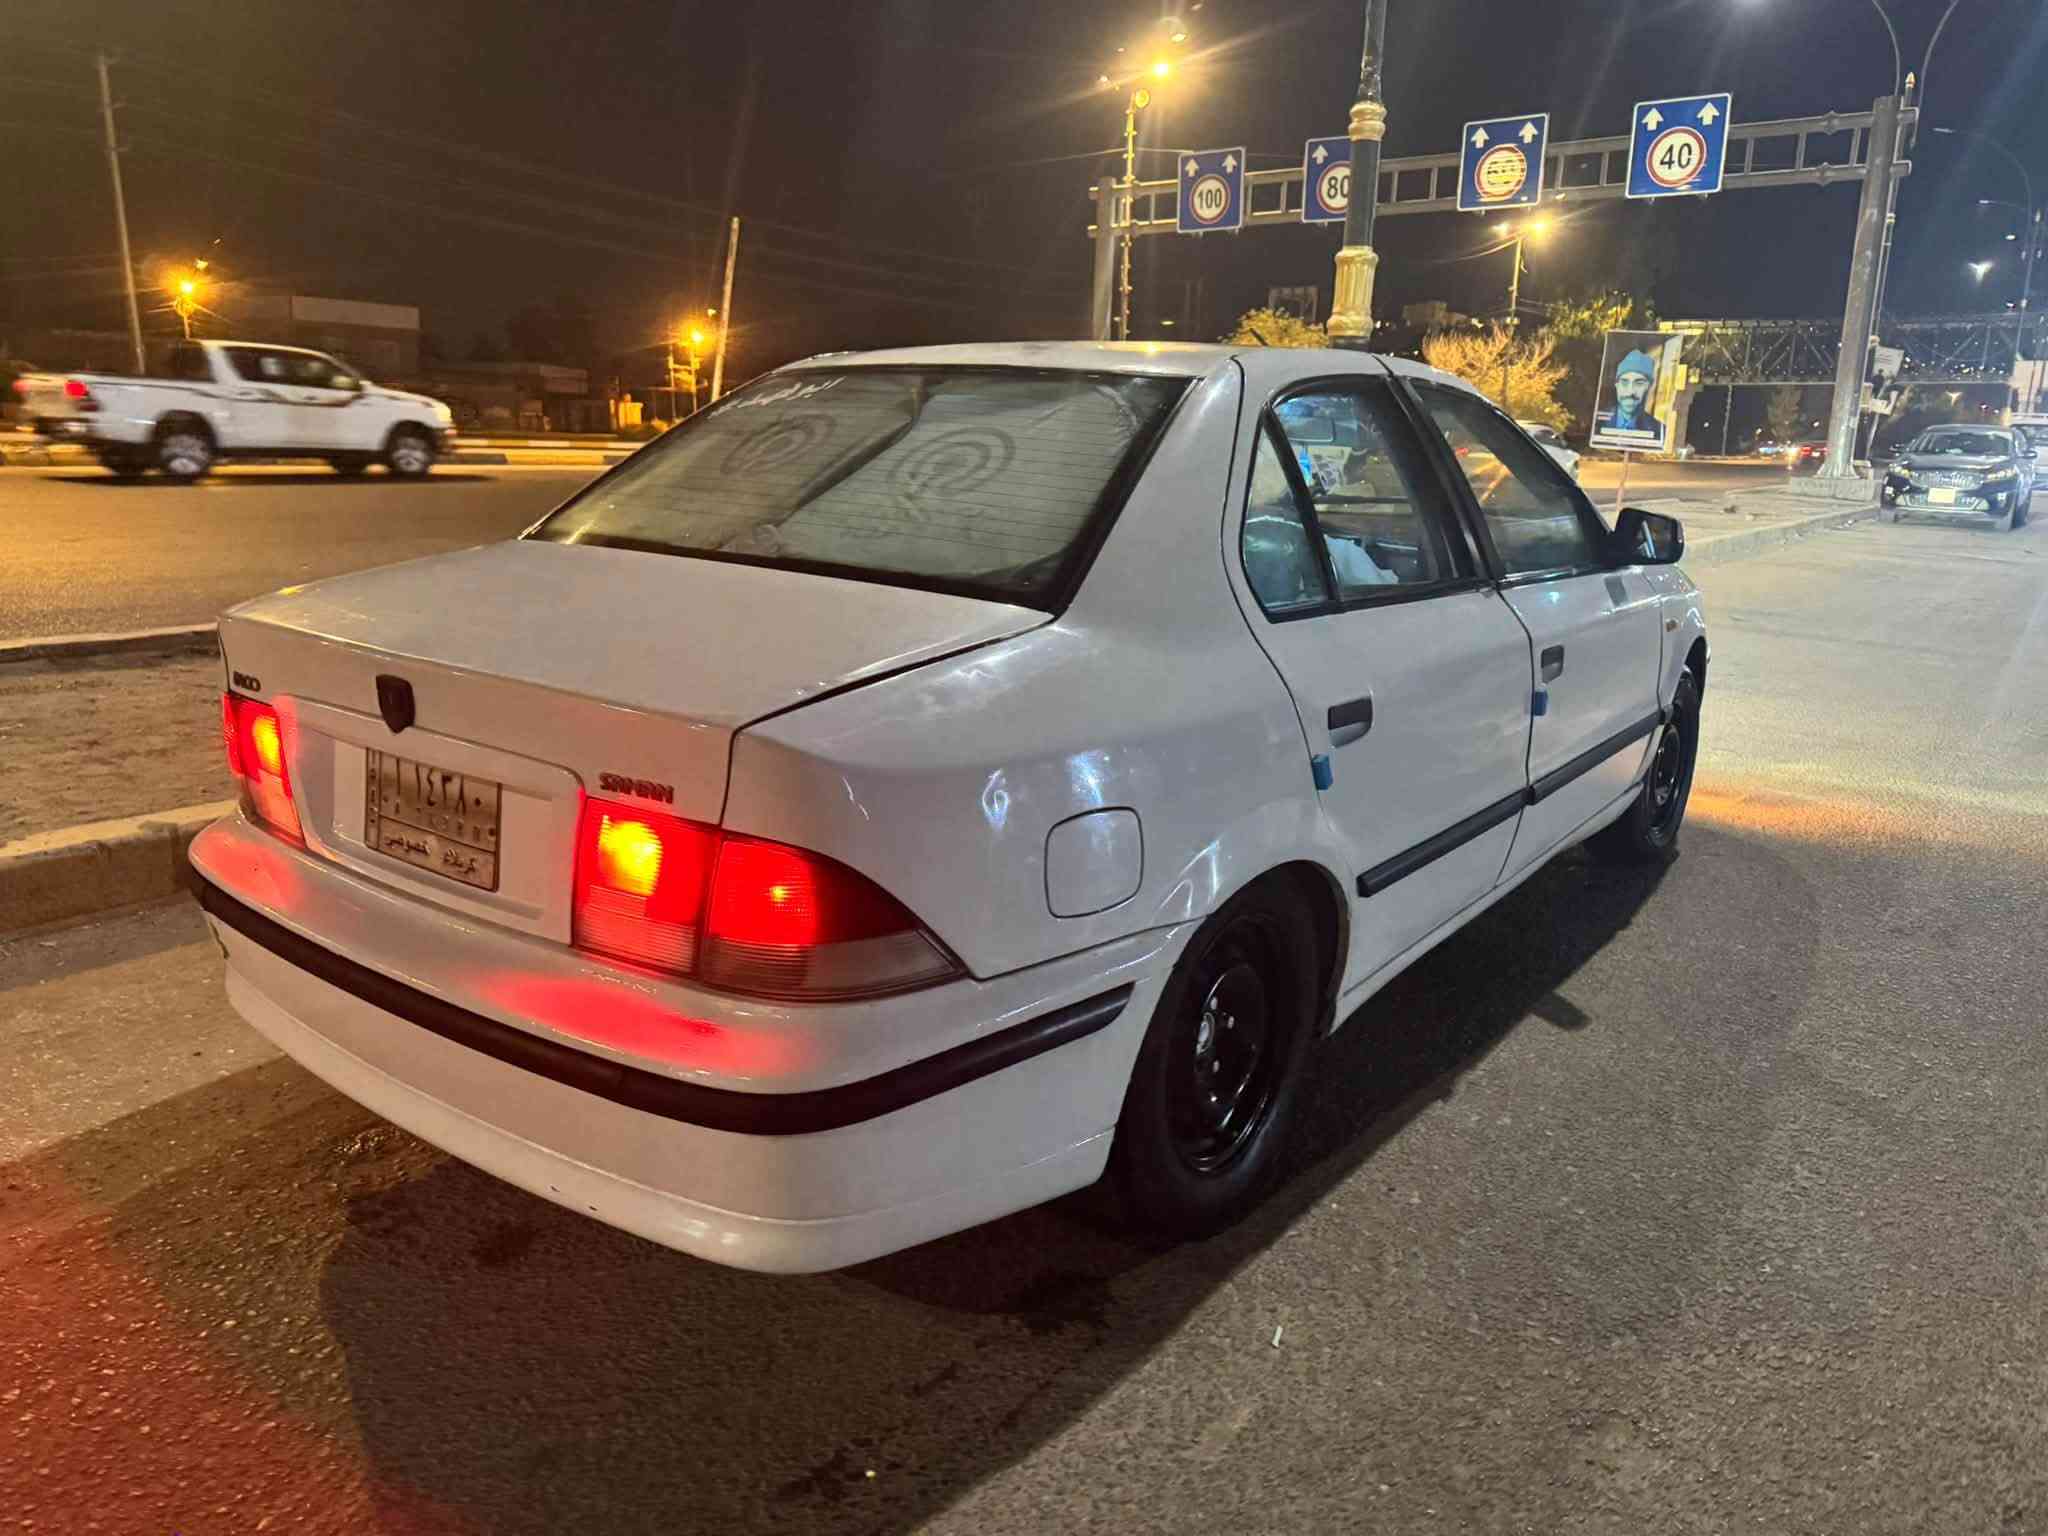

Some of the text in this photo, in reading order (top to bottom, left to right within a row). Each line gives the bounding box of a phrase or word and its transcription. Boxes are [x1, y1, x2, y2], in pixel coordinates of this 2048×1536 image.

[1659, 143, 1692, 170] 40
[1198, 188, 1222, 209] 100
[1327, 175, 1349, 199] 80
